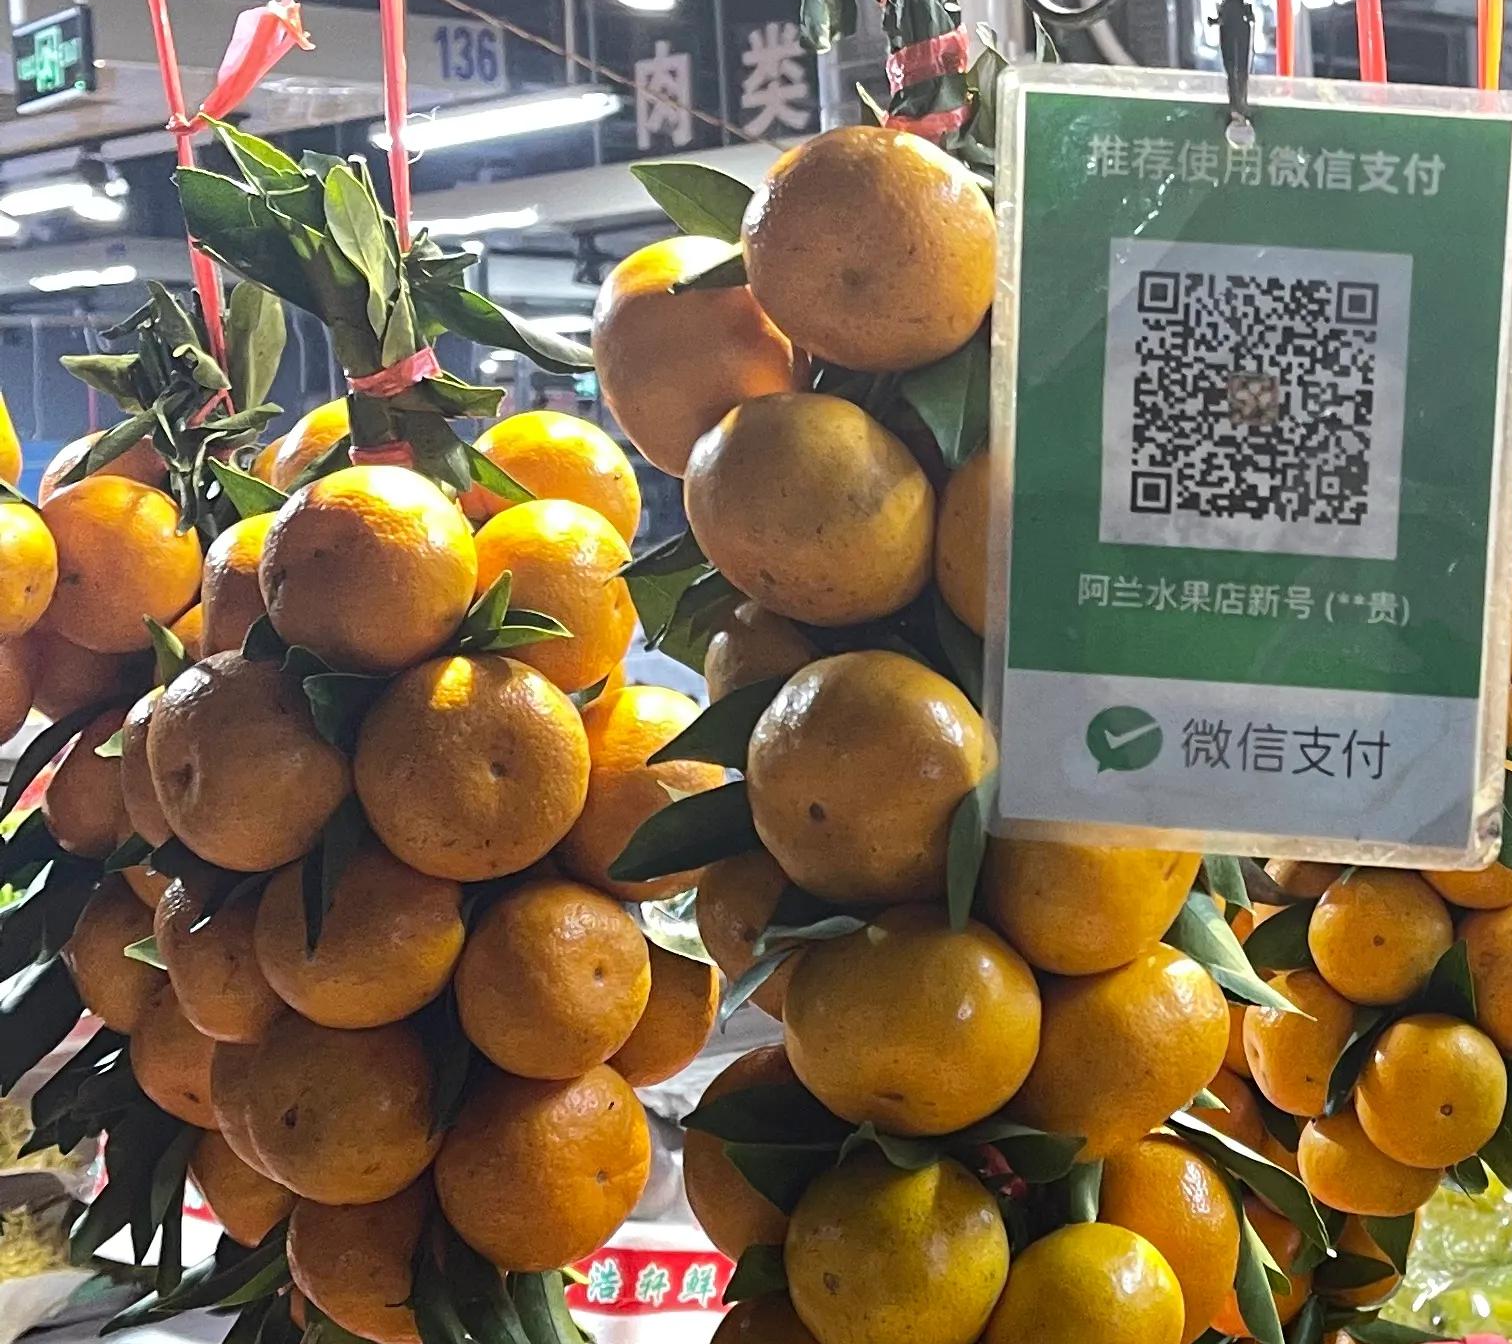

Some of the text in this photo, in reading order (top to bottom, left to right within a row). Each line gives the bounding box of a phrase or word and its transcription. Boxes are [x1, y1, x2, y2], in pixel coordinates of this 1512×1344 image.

[433, 25, 498, 83] 136
[634, 21, 811, 150] 肉类
[1087, 133, 1446, 197] 推荐使用微信支付
[1180, 717, 1391, 780] 微信支付
